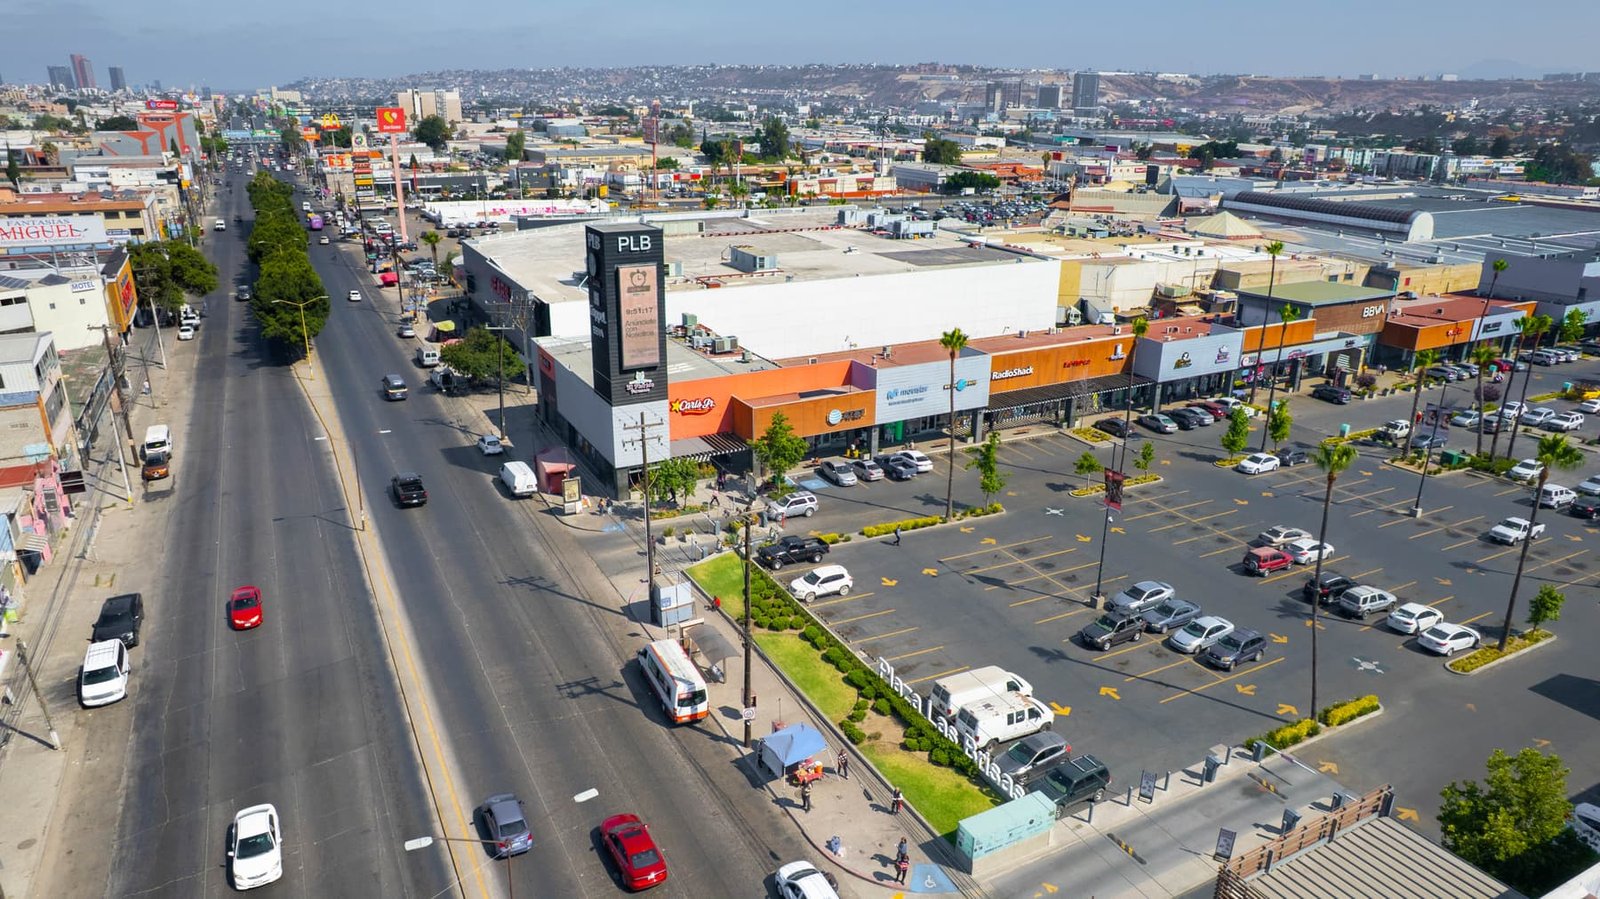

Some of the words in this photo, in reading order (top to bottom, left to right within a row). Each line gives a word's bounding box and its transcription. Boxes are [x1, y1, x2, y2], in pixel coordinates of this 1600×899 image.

[7, 218, 71, 227] FANTASIAS
[0, 224, 81, 241] MIGUEL
[617, 235, 652, 253] PLB
[72, 281, 95, 290] MOTEL
[1362, 303, 1385, 319] BBVA
[991, 366, 1035, 380] RadioShack
[879, 656, 922, 714] Plaza
[927, 699, 959, 745] Las
[965, 732, 1025, 801] Brisas
